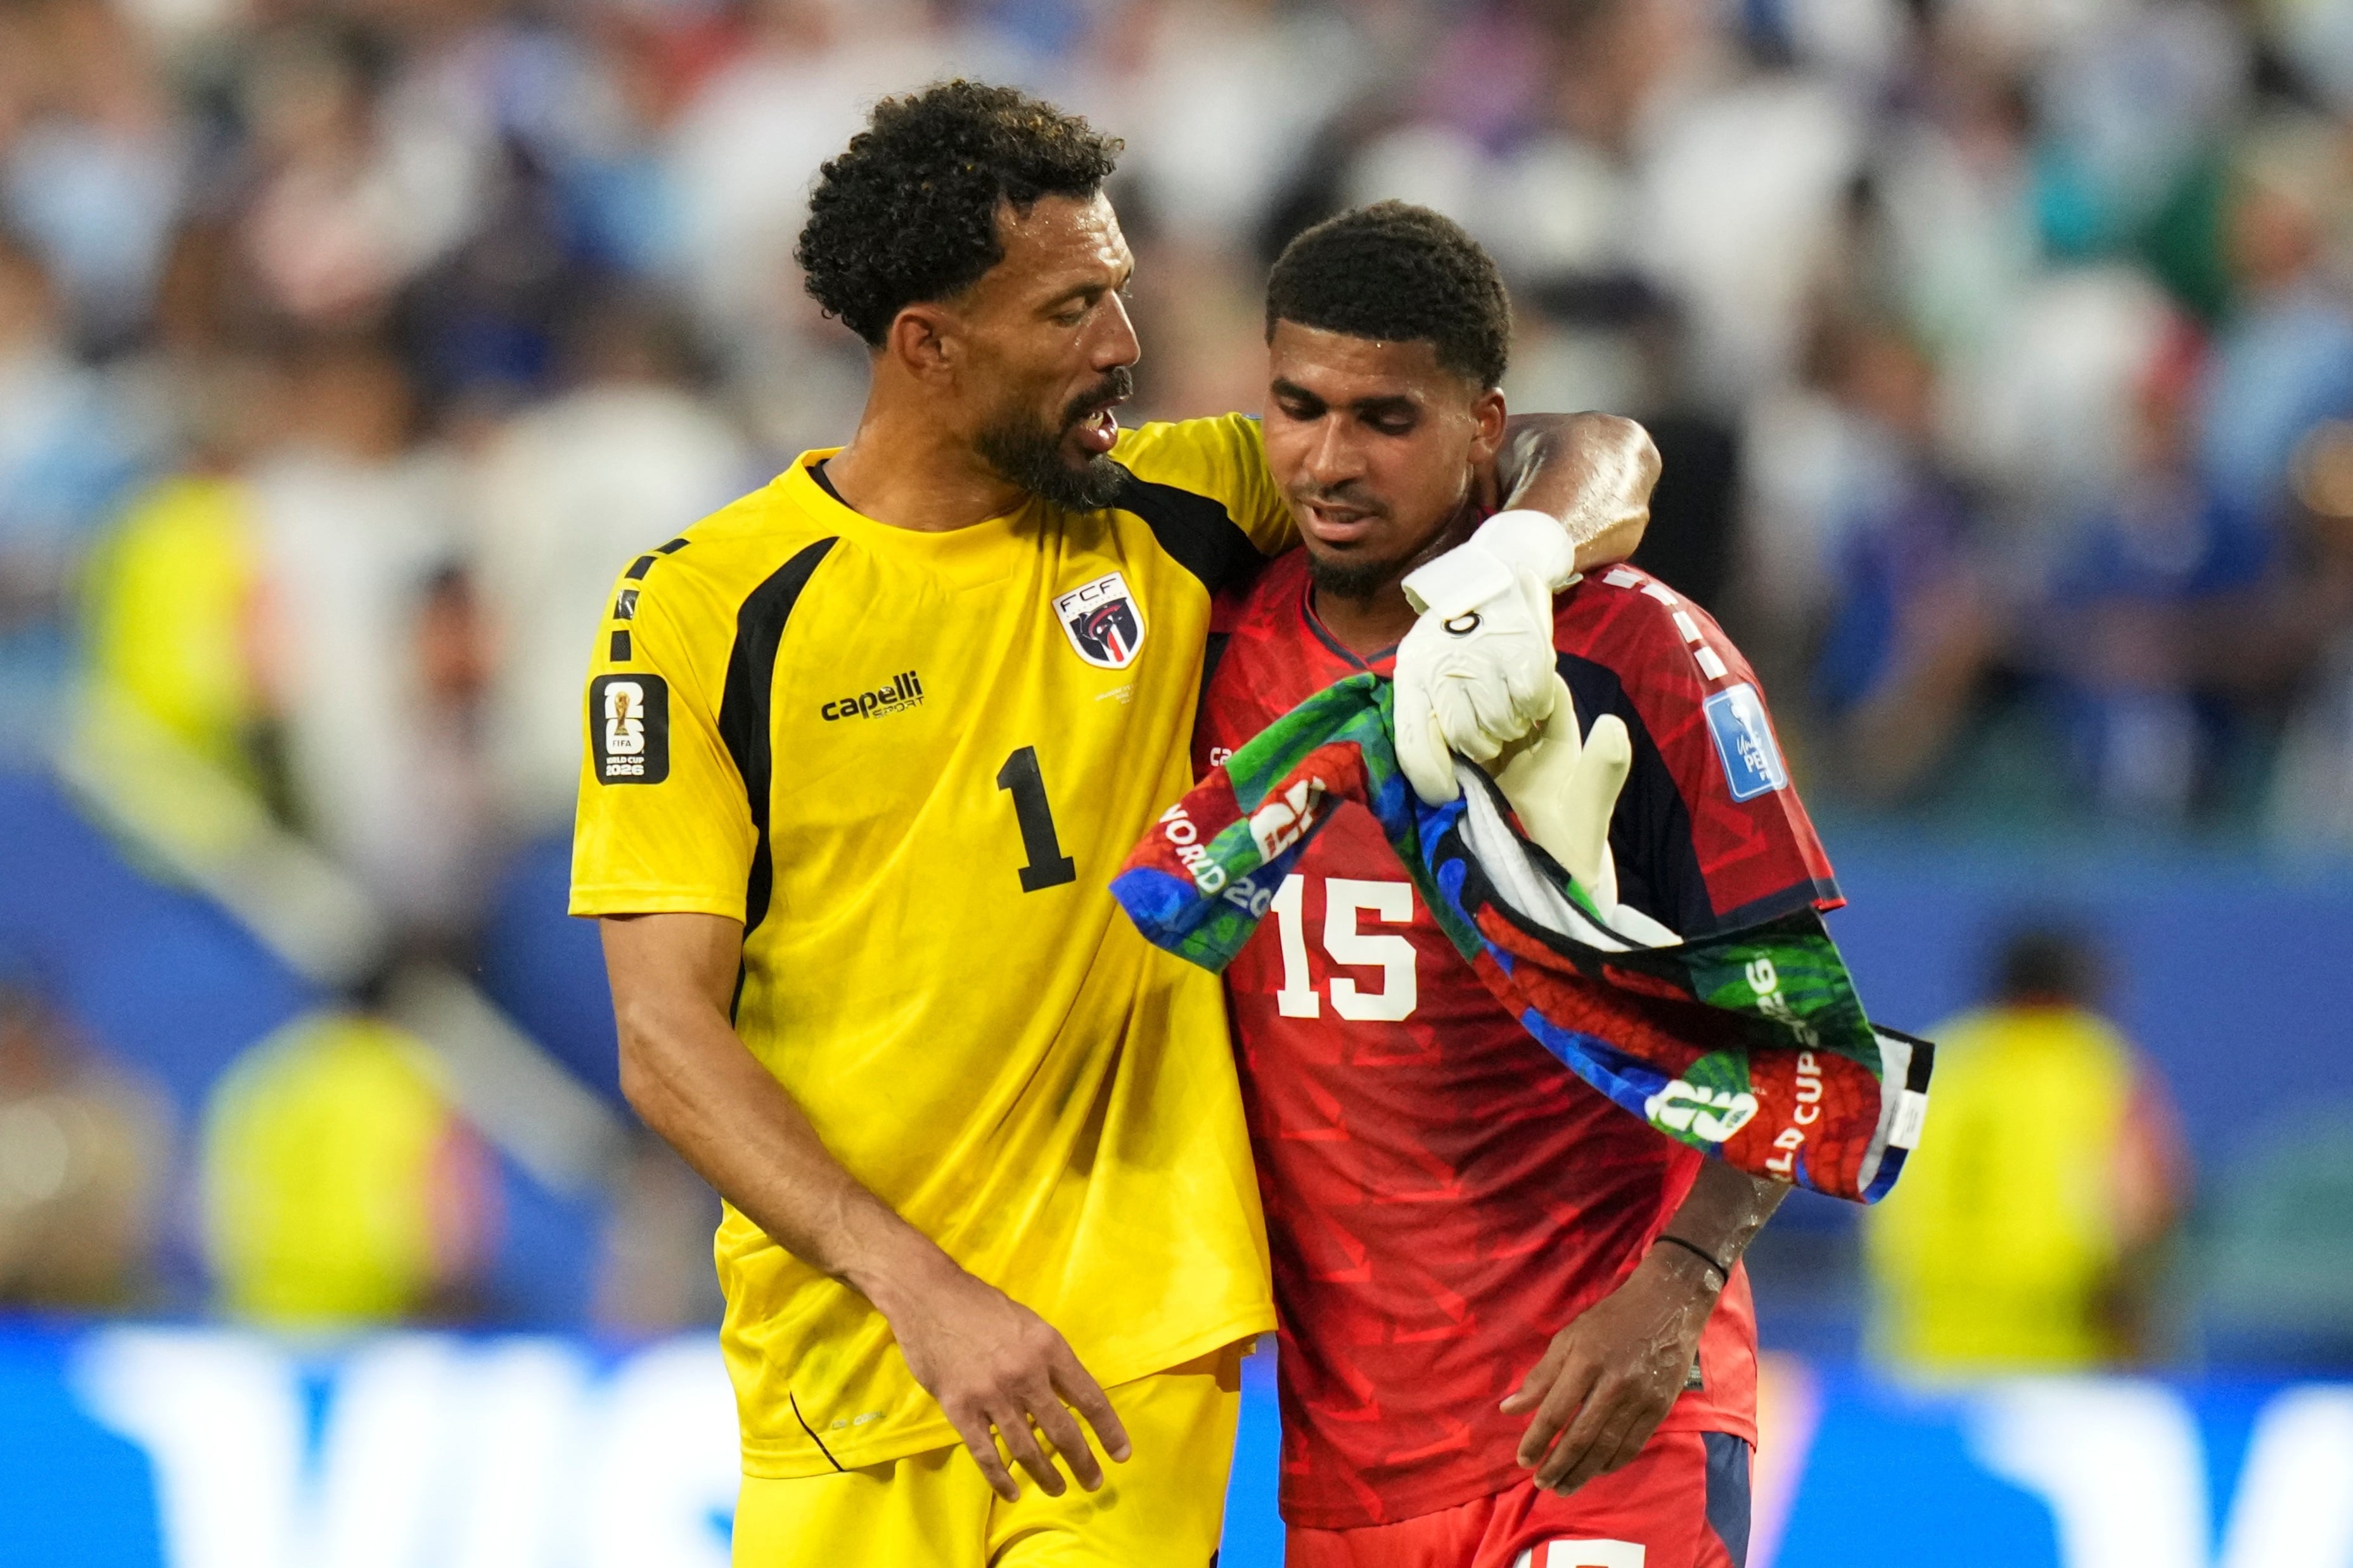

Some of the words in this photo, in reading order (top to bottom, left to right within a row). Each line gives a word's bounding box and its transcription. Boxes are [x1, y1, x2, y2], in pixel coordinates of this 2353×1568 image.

[1060, 578, 1117, 612] FCF
[821, 670, 923, 722] capelli
[606, 765, 644, 776] 2026
[627, 756, 644, 765] CUP
[996, 745, 1076, 893] 1
[1270, 874, 1417, 1021] 15
[1793, 1051, 1823, 1125] CUP
